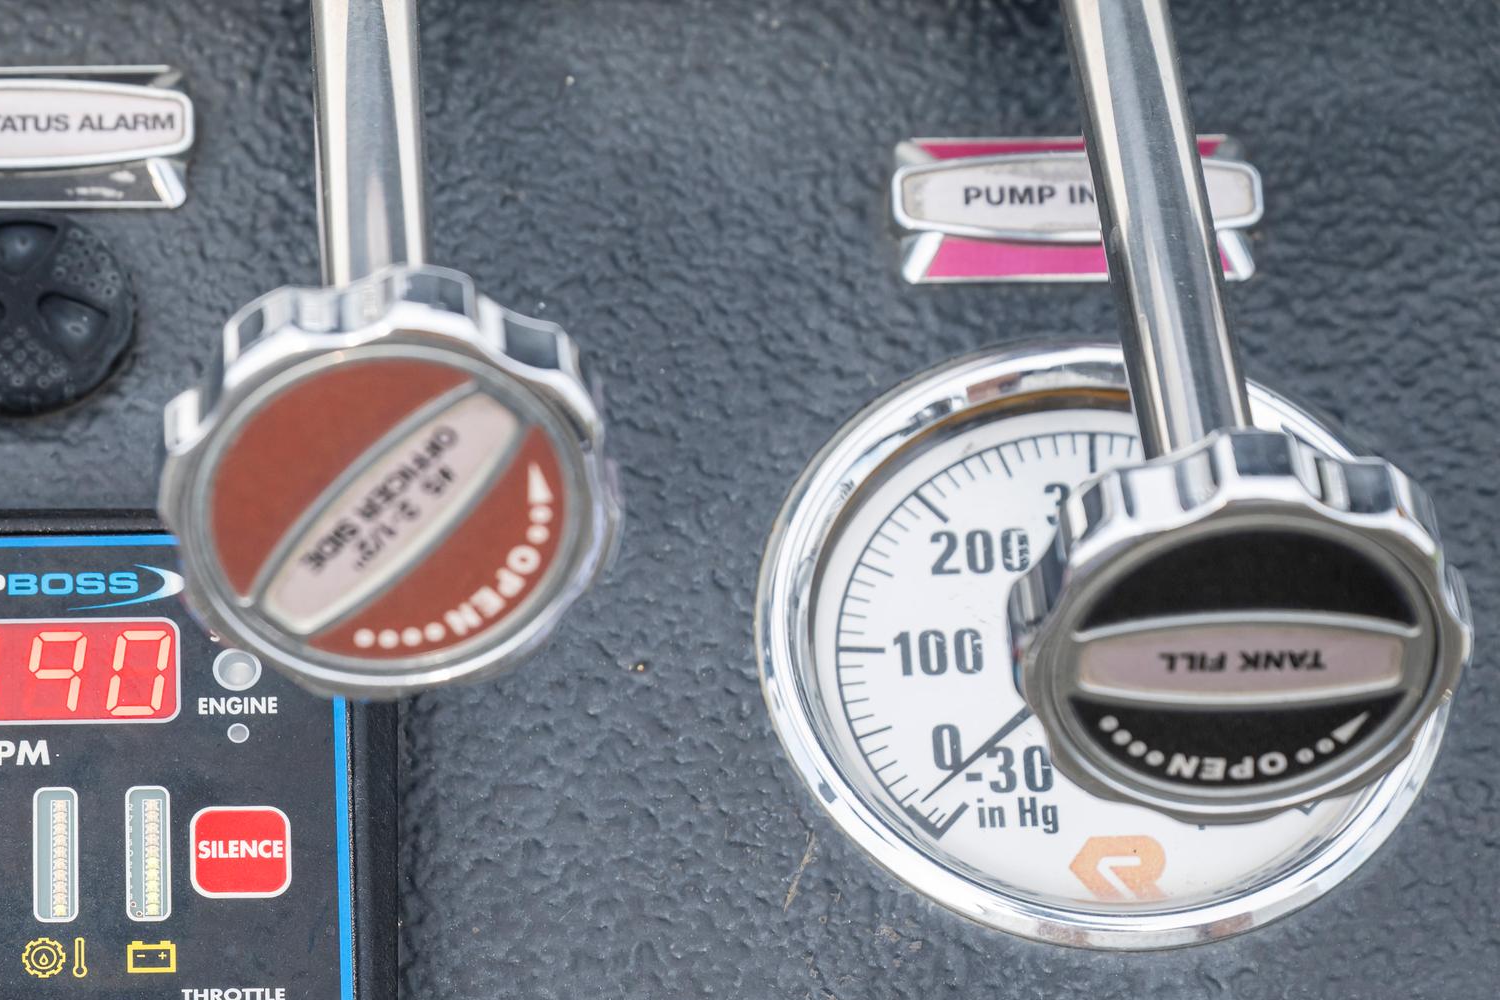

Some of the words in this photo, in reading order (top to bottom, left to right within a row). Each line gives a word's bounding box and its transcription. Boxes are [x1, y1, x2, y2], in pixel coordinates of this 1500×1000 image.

[78, 112, 175, 131] ALARM
[963, 185, 1055, 206] PUMP
[360, 425, 458, 522] OFFICER
[301, 521, 360, 575] SIDE
[930, 527, 1030, 575] 200
[443, 545, 541, 637] OPEN
[892, 629, 984, 677] 100
[1160, 651, 1228, 673] FILL
[1237, 650, 1327, 671] TANK
[198, 696, 278, 715] ENGINE
[932, 723, 962, 771] 0
[1167, 749, 1288, 781] OPEN
[965, 745, 1054, 793] -30
[977, 797, 1006, 828] in
[1018, 796, 1059, 834] Hg
[198, 840, 284, 860] SILENCE
